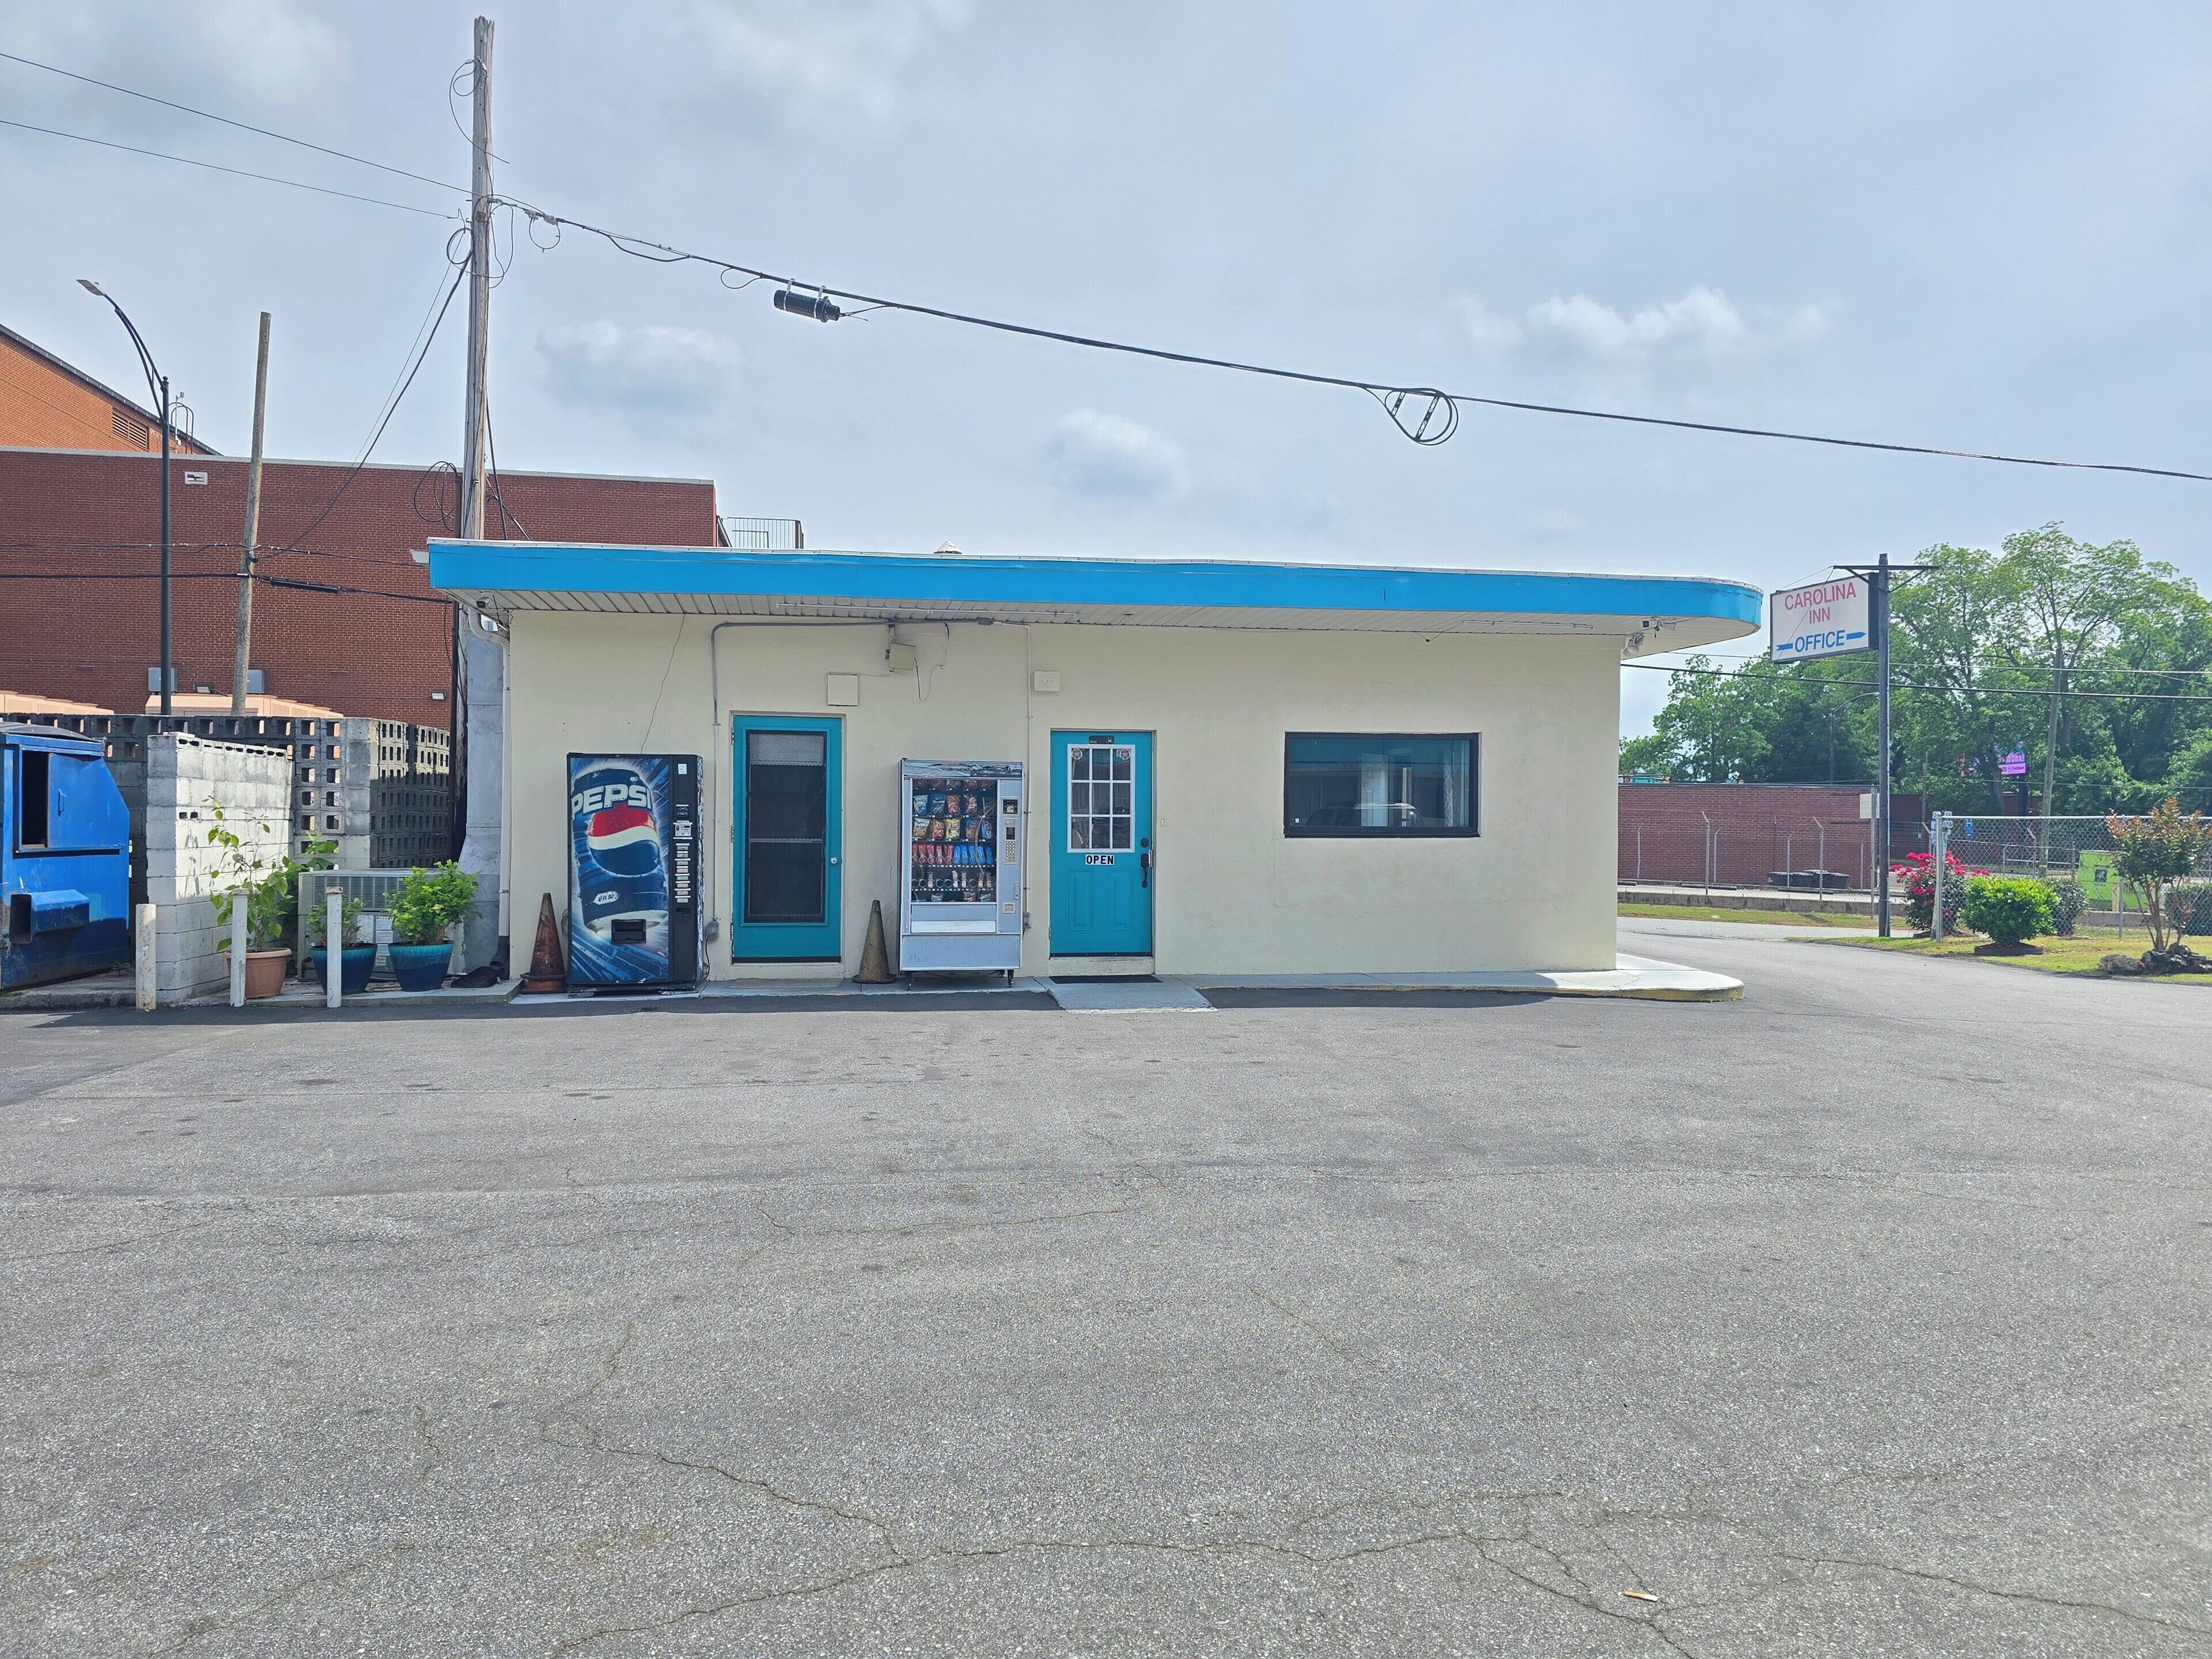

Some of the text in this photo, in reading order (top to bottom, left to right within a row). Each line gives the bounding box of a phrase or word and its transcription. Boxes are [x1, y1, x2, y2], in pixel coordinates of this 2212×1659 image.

[1785, 582, 1856, 611] CAROLINA
[1809, 607, 1831, 624] INN
[1794, 630, 1845, 653] OFFICE
[571, 784, 652, 821] PEPSI
[1086, 855, 1113, 865] OPEN
